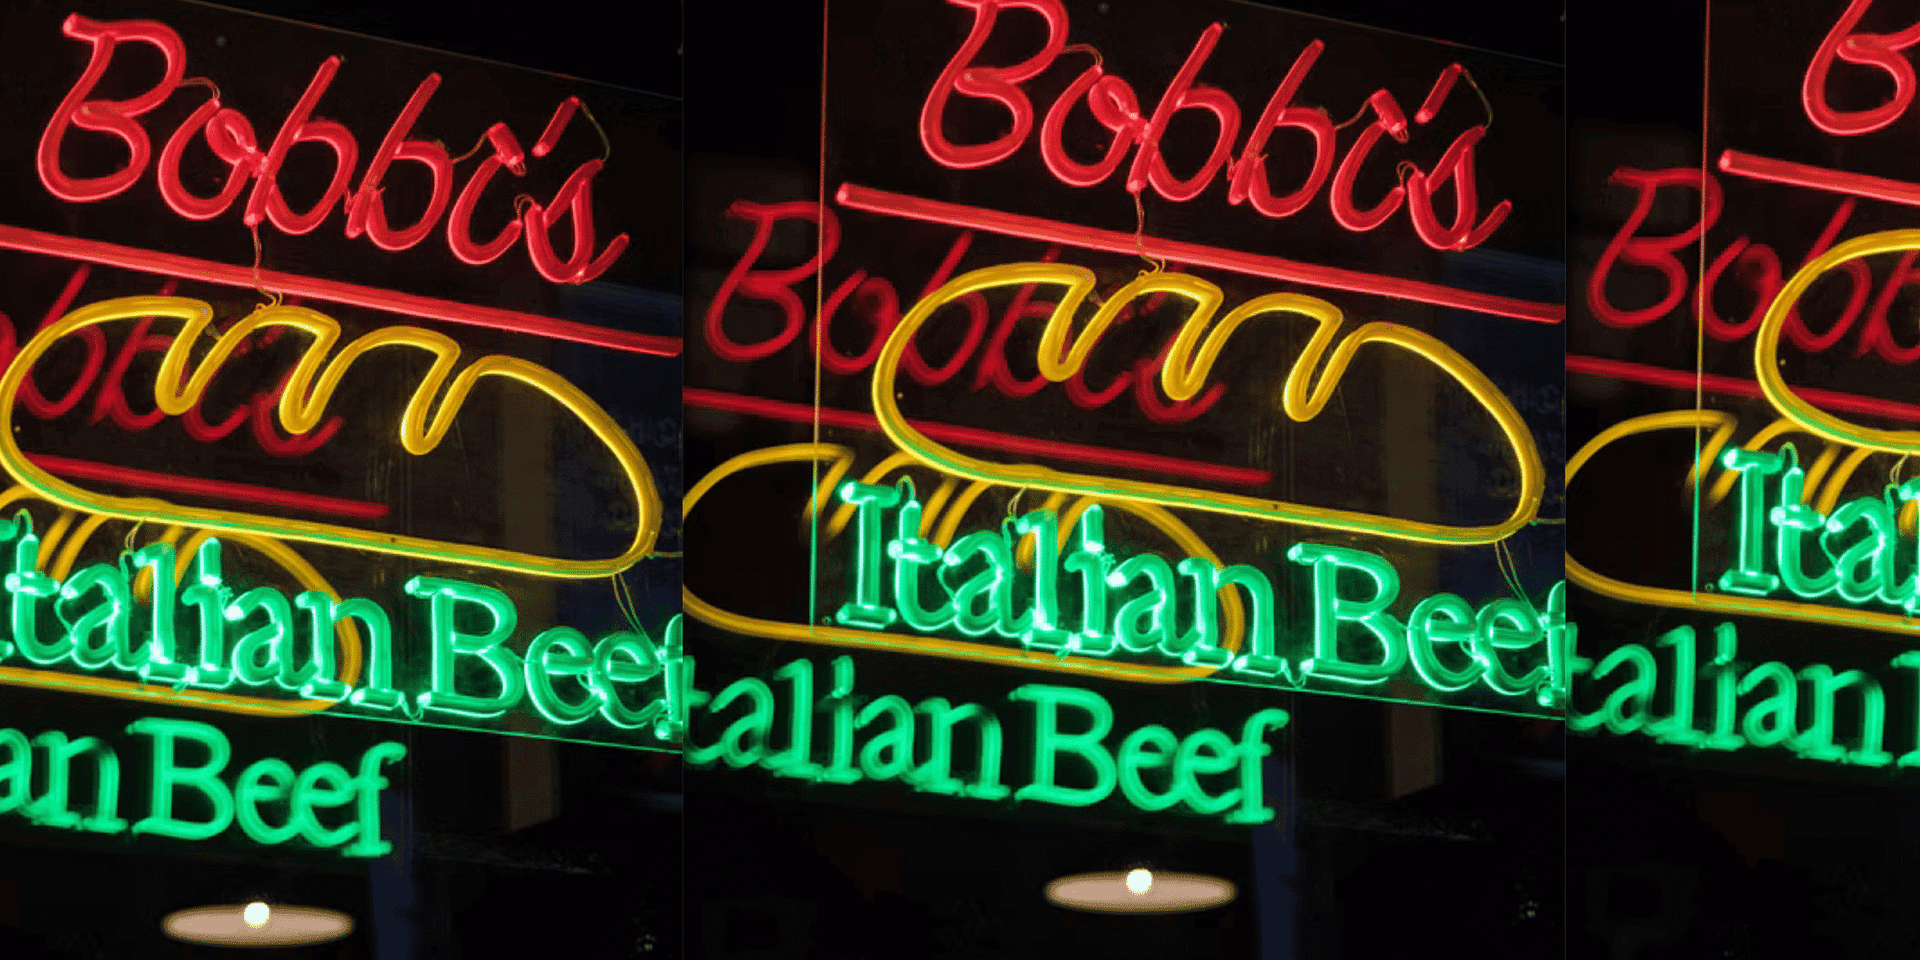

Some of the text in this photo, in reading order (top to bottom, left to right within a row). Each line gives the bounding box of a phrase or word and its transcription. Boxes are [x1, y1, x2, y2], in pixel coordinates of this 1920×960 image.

[38, 12, 630, 285] Bobbi's
[920, 0, 1512, 251] Bobbi's
[836, 480, 1284, 677] Italian
[127, 717, 407, 858] Beef
[1009, 684, 1290, 824] Beef
